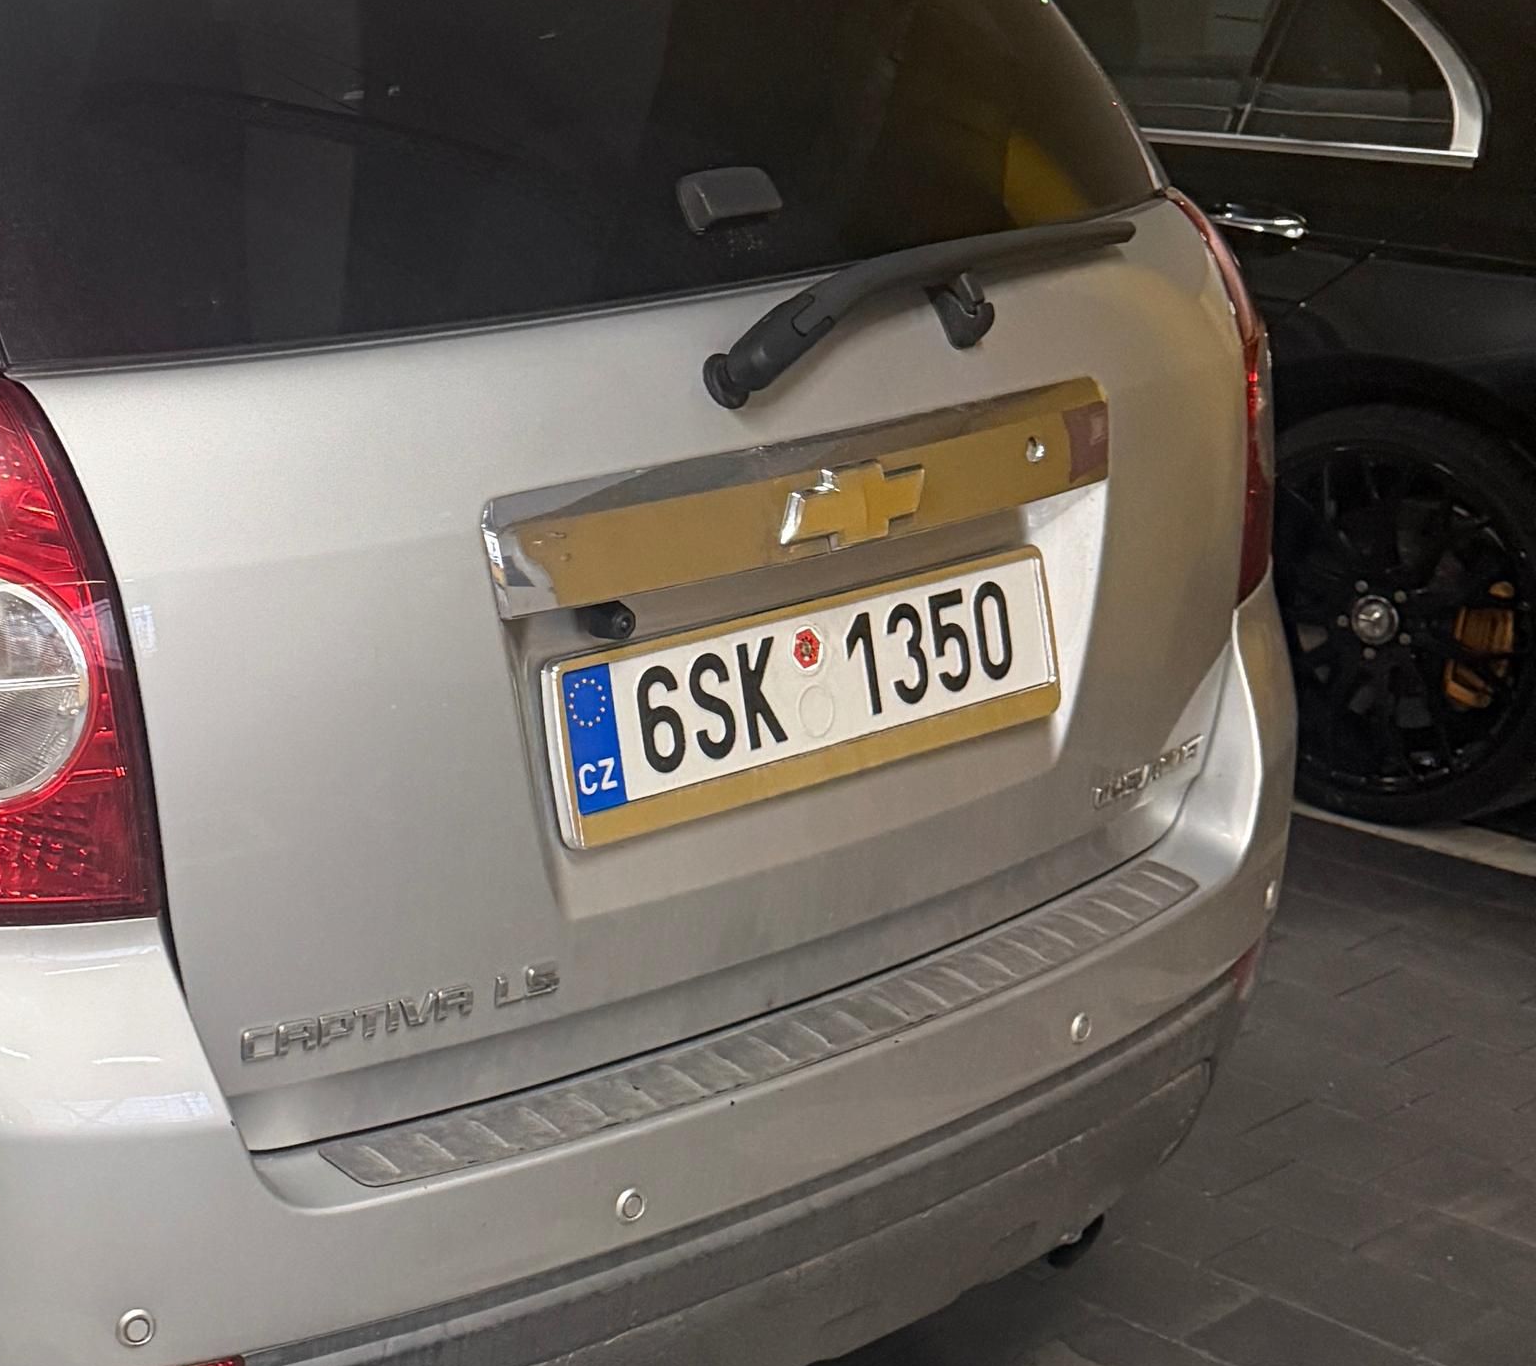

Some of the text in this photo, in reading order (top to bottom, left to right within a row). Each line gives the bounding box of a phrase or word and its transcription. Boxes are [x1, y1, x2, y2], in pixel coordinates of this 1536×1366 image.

[635, 580, 1013, 774] 6SK 1350
[578, 756, 618, 796] CZ
[240, 960, 561, 1062] CAPTIVA LS
